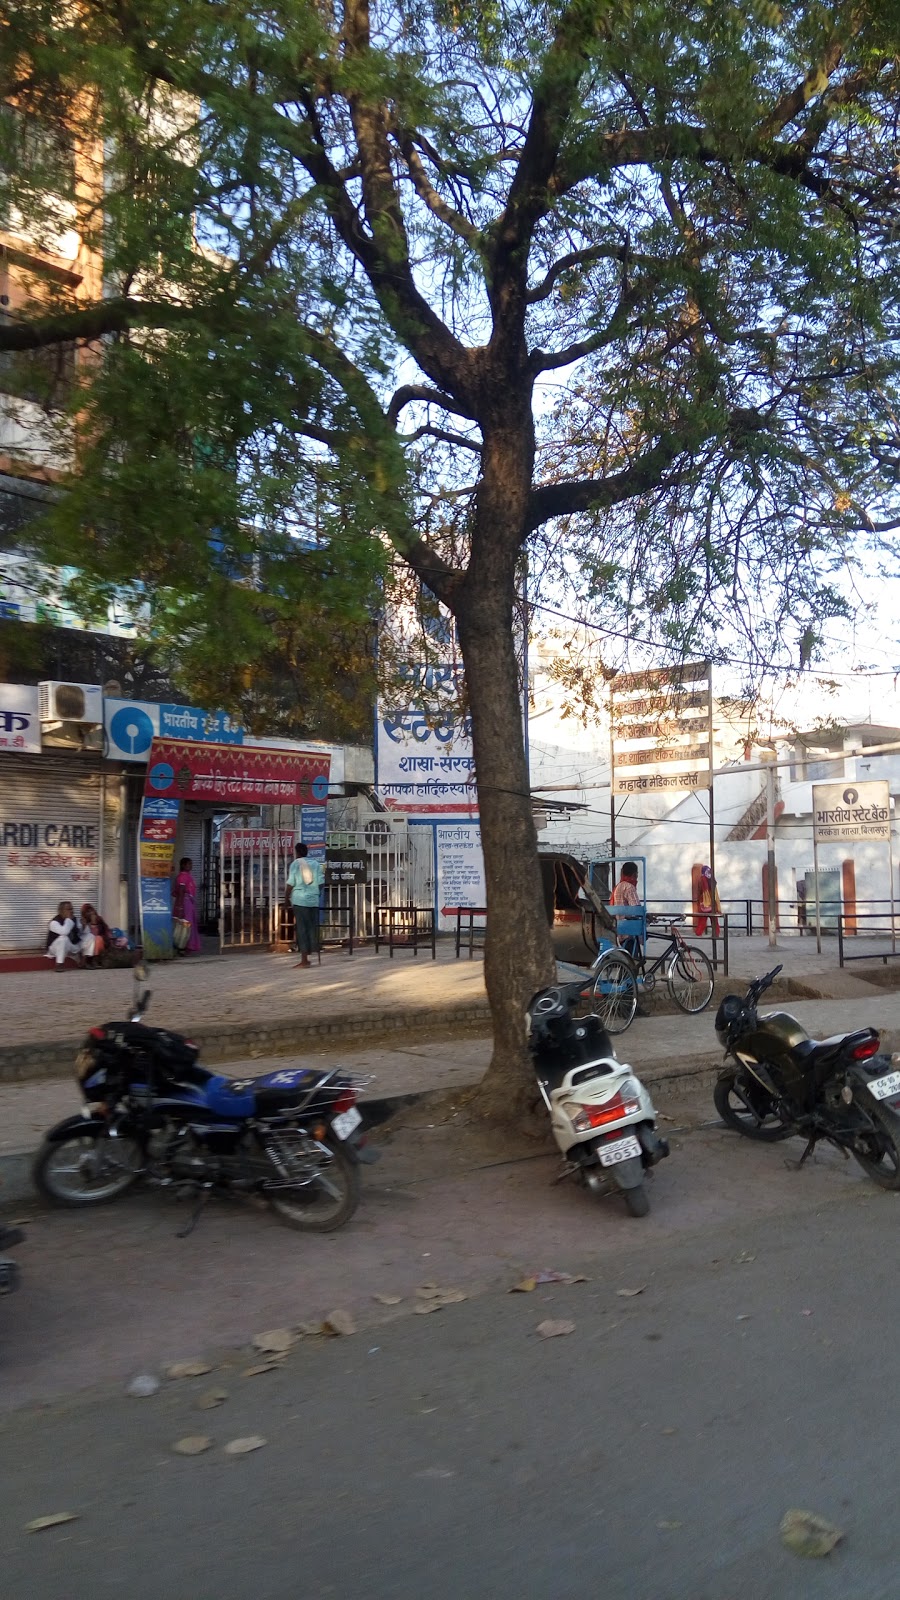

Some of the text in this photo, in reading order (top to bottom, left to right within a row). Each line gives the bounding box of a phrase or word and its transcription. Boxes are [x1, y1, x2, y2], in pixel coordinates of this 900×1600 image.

[163, 710, 198, 730] भारतीय
[628, 750, 654, 763] शालिनी
[619, 772, 699, 792] महादेव मेडिकल स्टोर्स
[816, 803, 888, 823] भारतीय स्टेट बैंक
[0, 822, 96, 849] RDI CARE
[438, 827, 471, 841] भारतीय
[818, 827, 840, 837] सरकंडा
[861, 824, 889, 837] बिलासपुर
[605, 1145, 639, 1163] 4051
